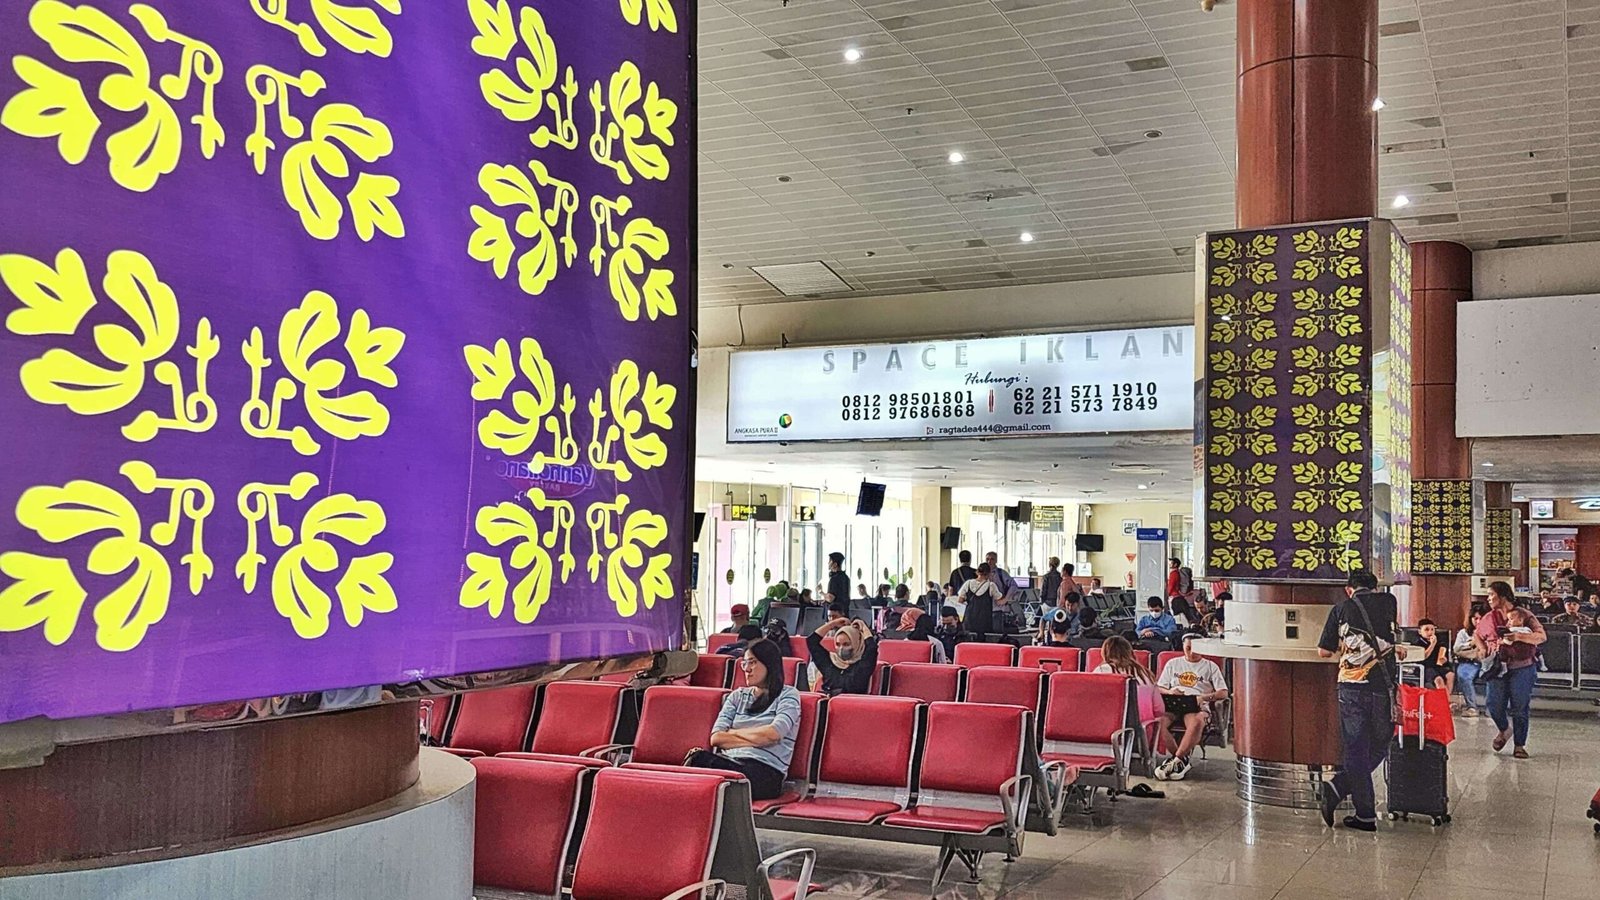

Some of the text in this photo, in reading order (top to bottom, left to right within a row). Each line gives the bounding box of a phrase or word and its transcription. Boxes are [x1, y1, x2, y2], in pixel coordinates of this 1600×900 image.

[823, 330, 1184, 374] SPACE IKLAN
[964, 371, 1021, 388] Hubungi
[842, 391, 974, 408] 0812 98501801
[1014, 382, 1157, 401] 62 21 571 1910
[842, 404, 975, 421] 0812 97686868
[1013, 396, 1158, 415] 62 21 573 7849
[939, 423, 1051, 435] ragtadea444@gmail.com
